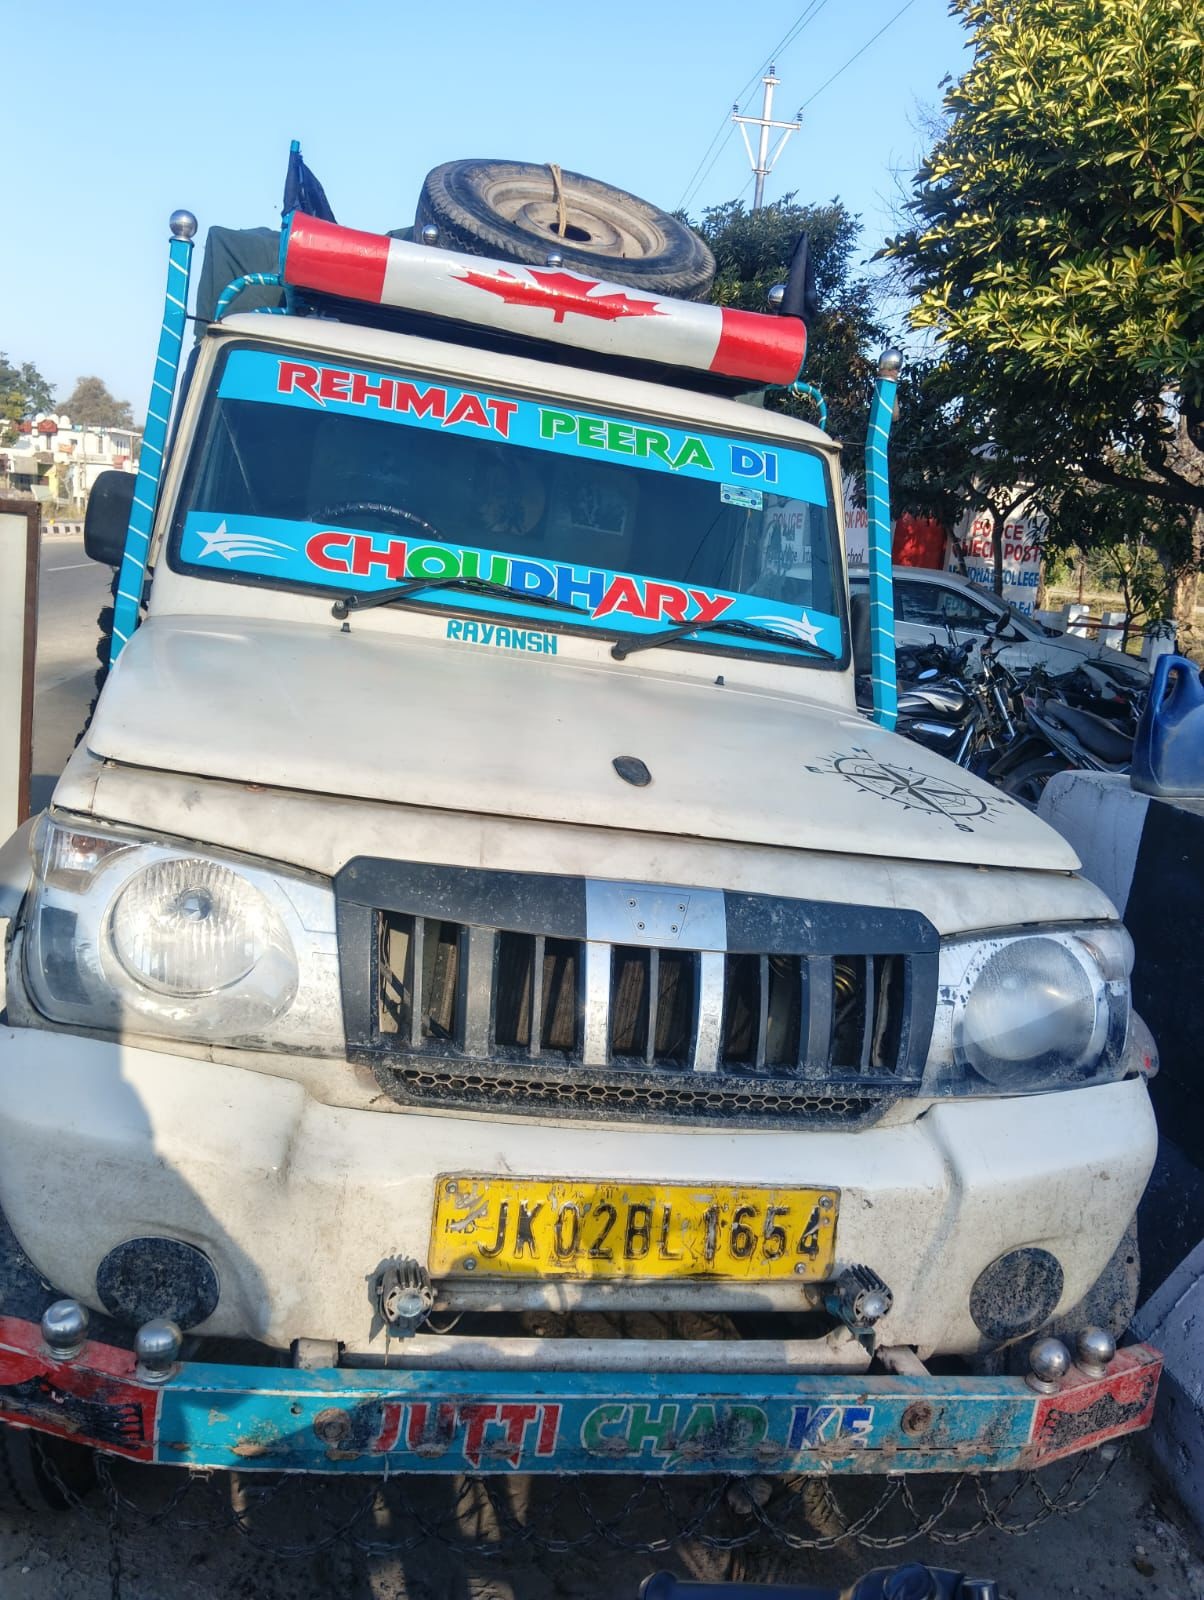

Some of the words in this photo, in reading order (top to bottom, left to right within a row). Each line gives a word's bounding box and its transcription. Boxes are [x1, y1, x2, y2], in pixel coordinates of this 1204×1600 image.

[277, 360, 518, 438] REHMAT
[538, 408, 715, 470] PEERA
[728, 445, 778, 483] DI
[972, 520, 1024, 541] POCE
[305, 531, 738, 623] CHOUDHARY
[446, 619, 558, 655] RAYANSH
[372, 1402, 563, 1469] JUTTI
[786, 1404, 875, 1471] KE
